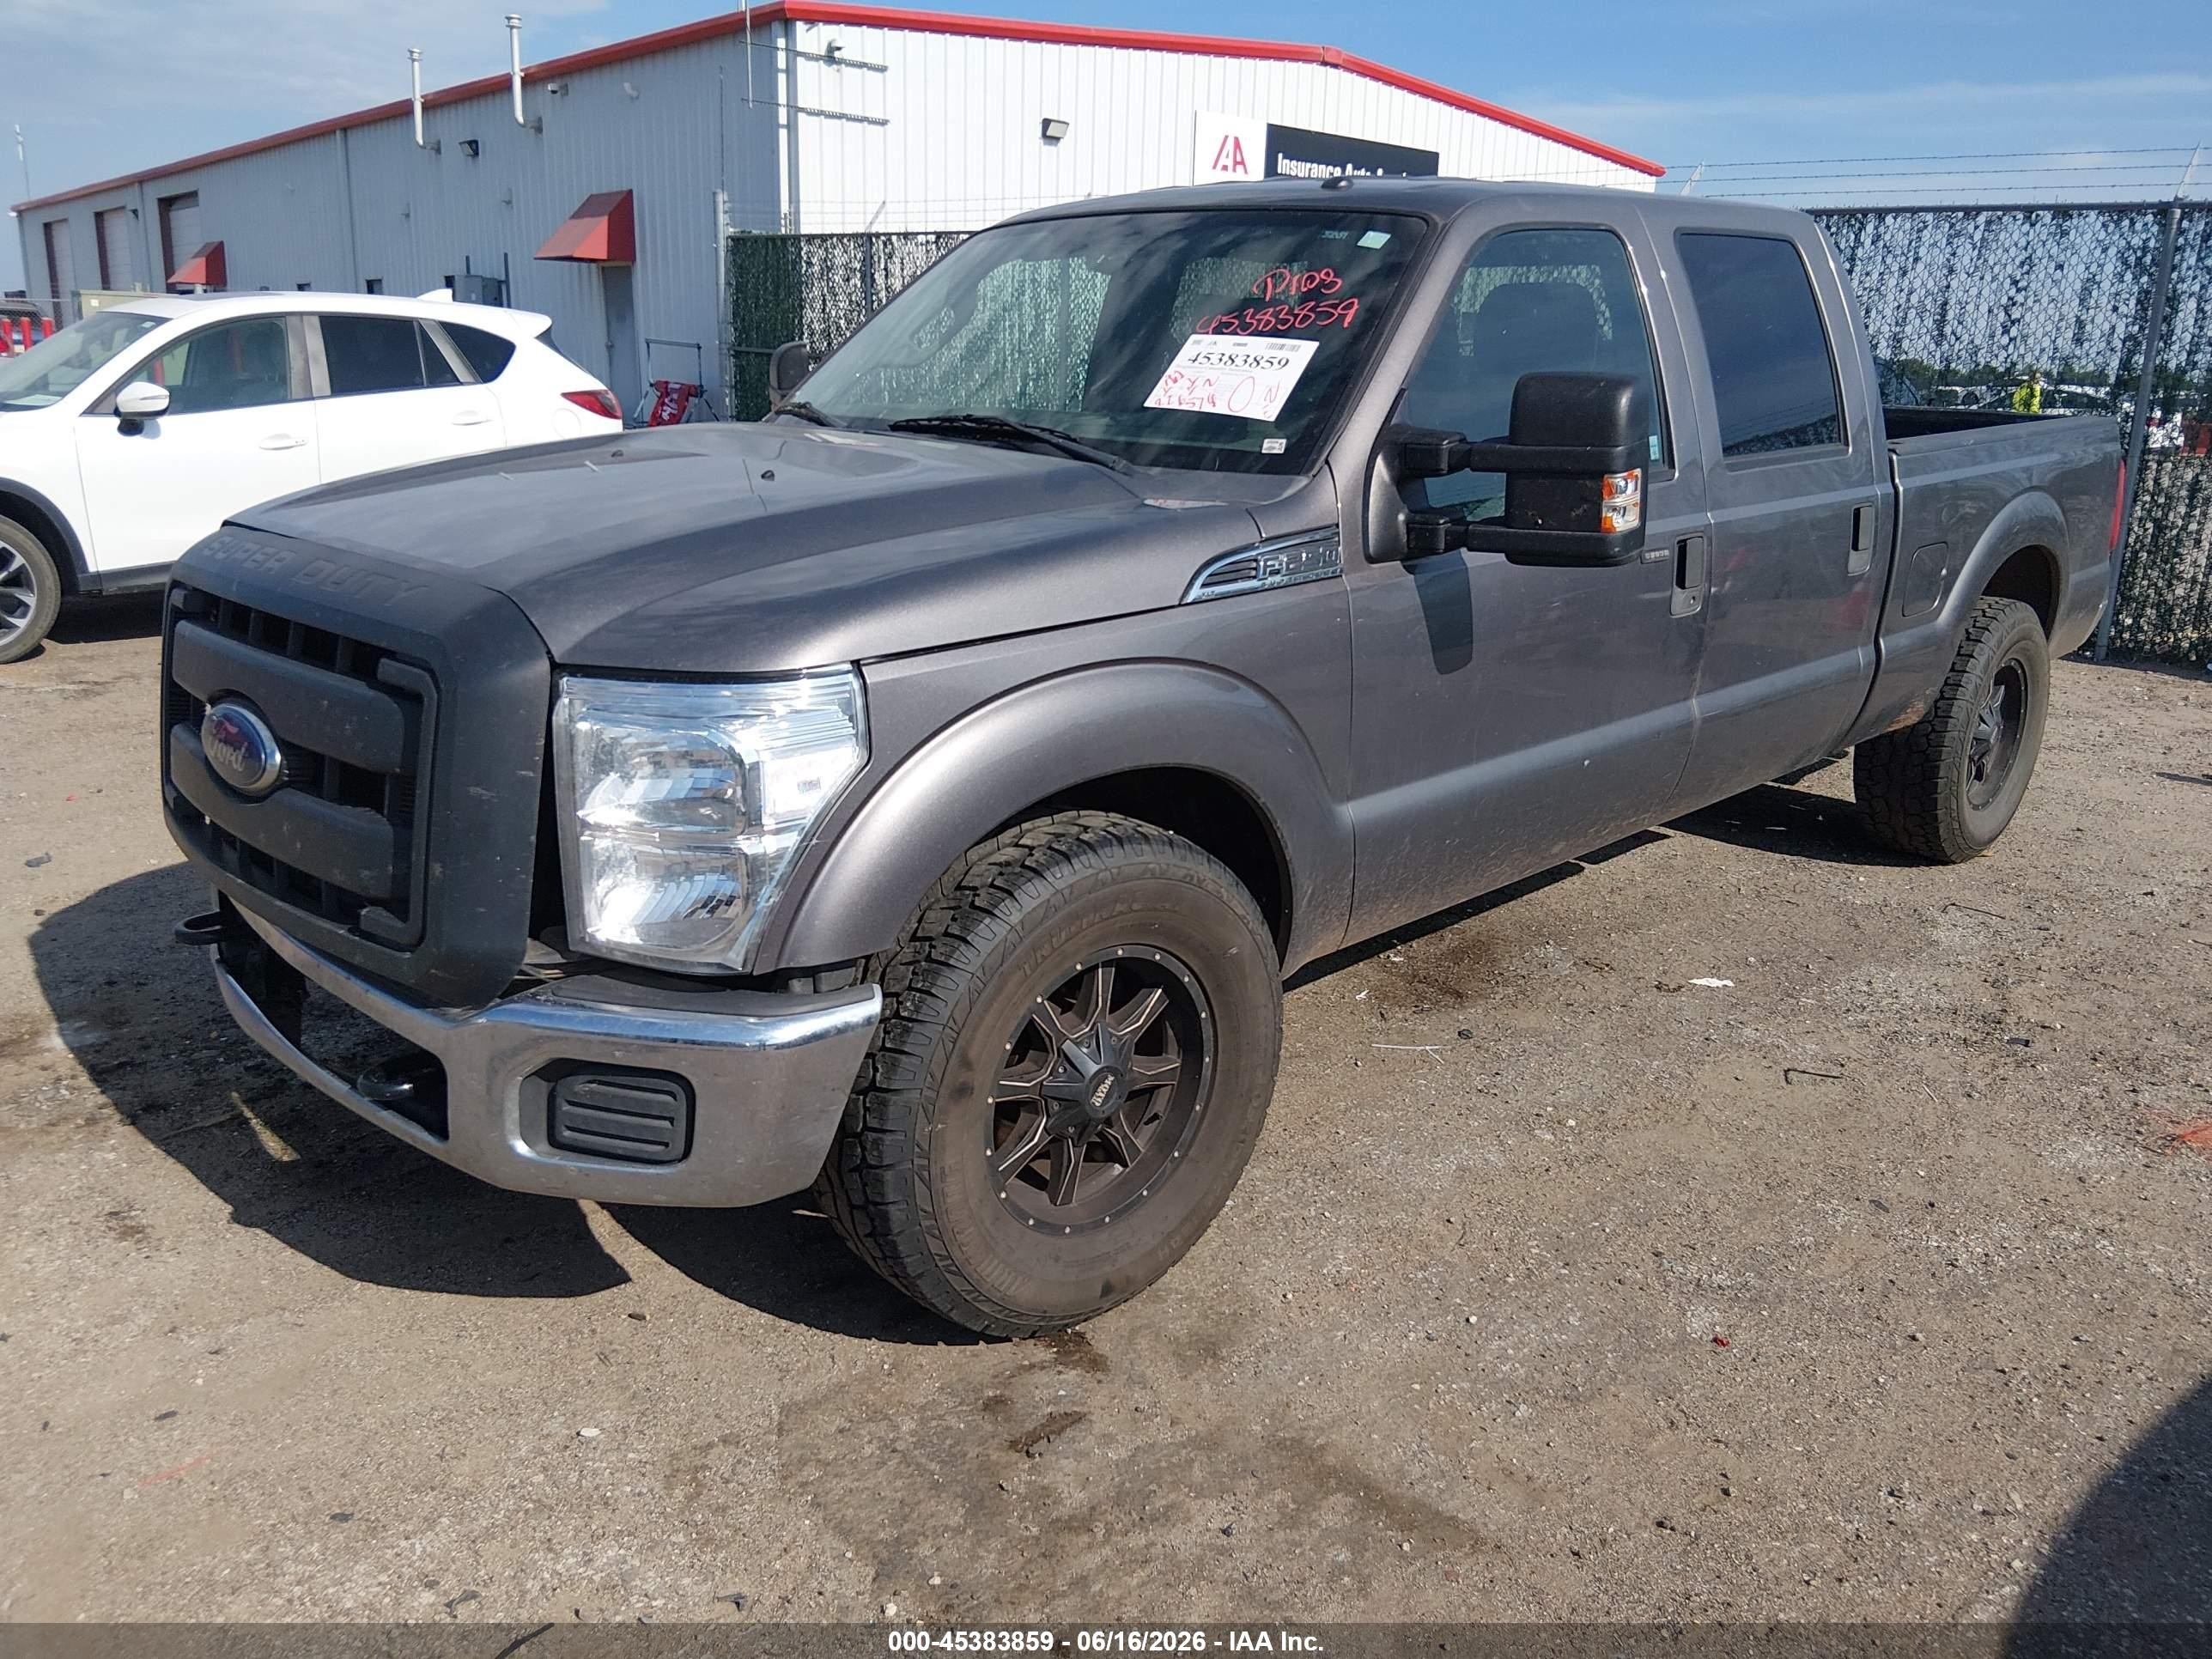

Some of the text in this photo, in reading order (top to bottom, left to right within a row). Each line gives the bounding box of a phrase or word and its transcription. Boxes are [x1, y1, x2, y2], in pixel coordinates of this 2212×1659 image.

[1195, 297, 1360, 335] 45383859
[1188, 350, 1291, 371] 45383859
[202, 535, 430, 606] SUPER DUTY
